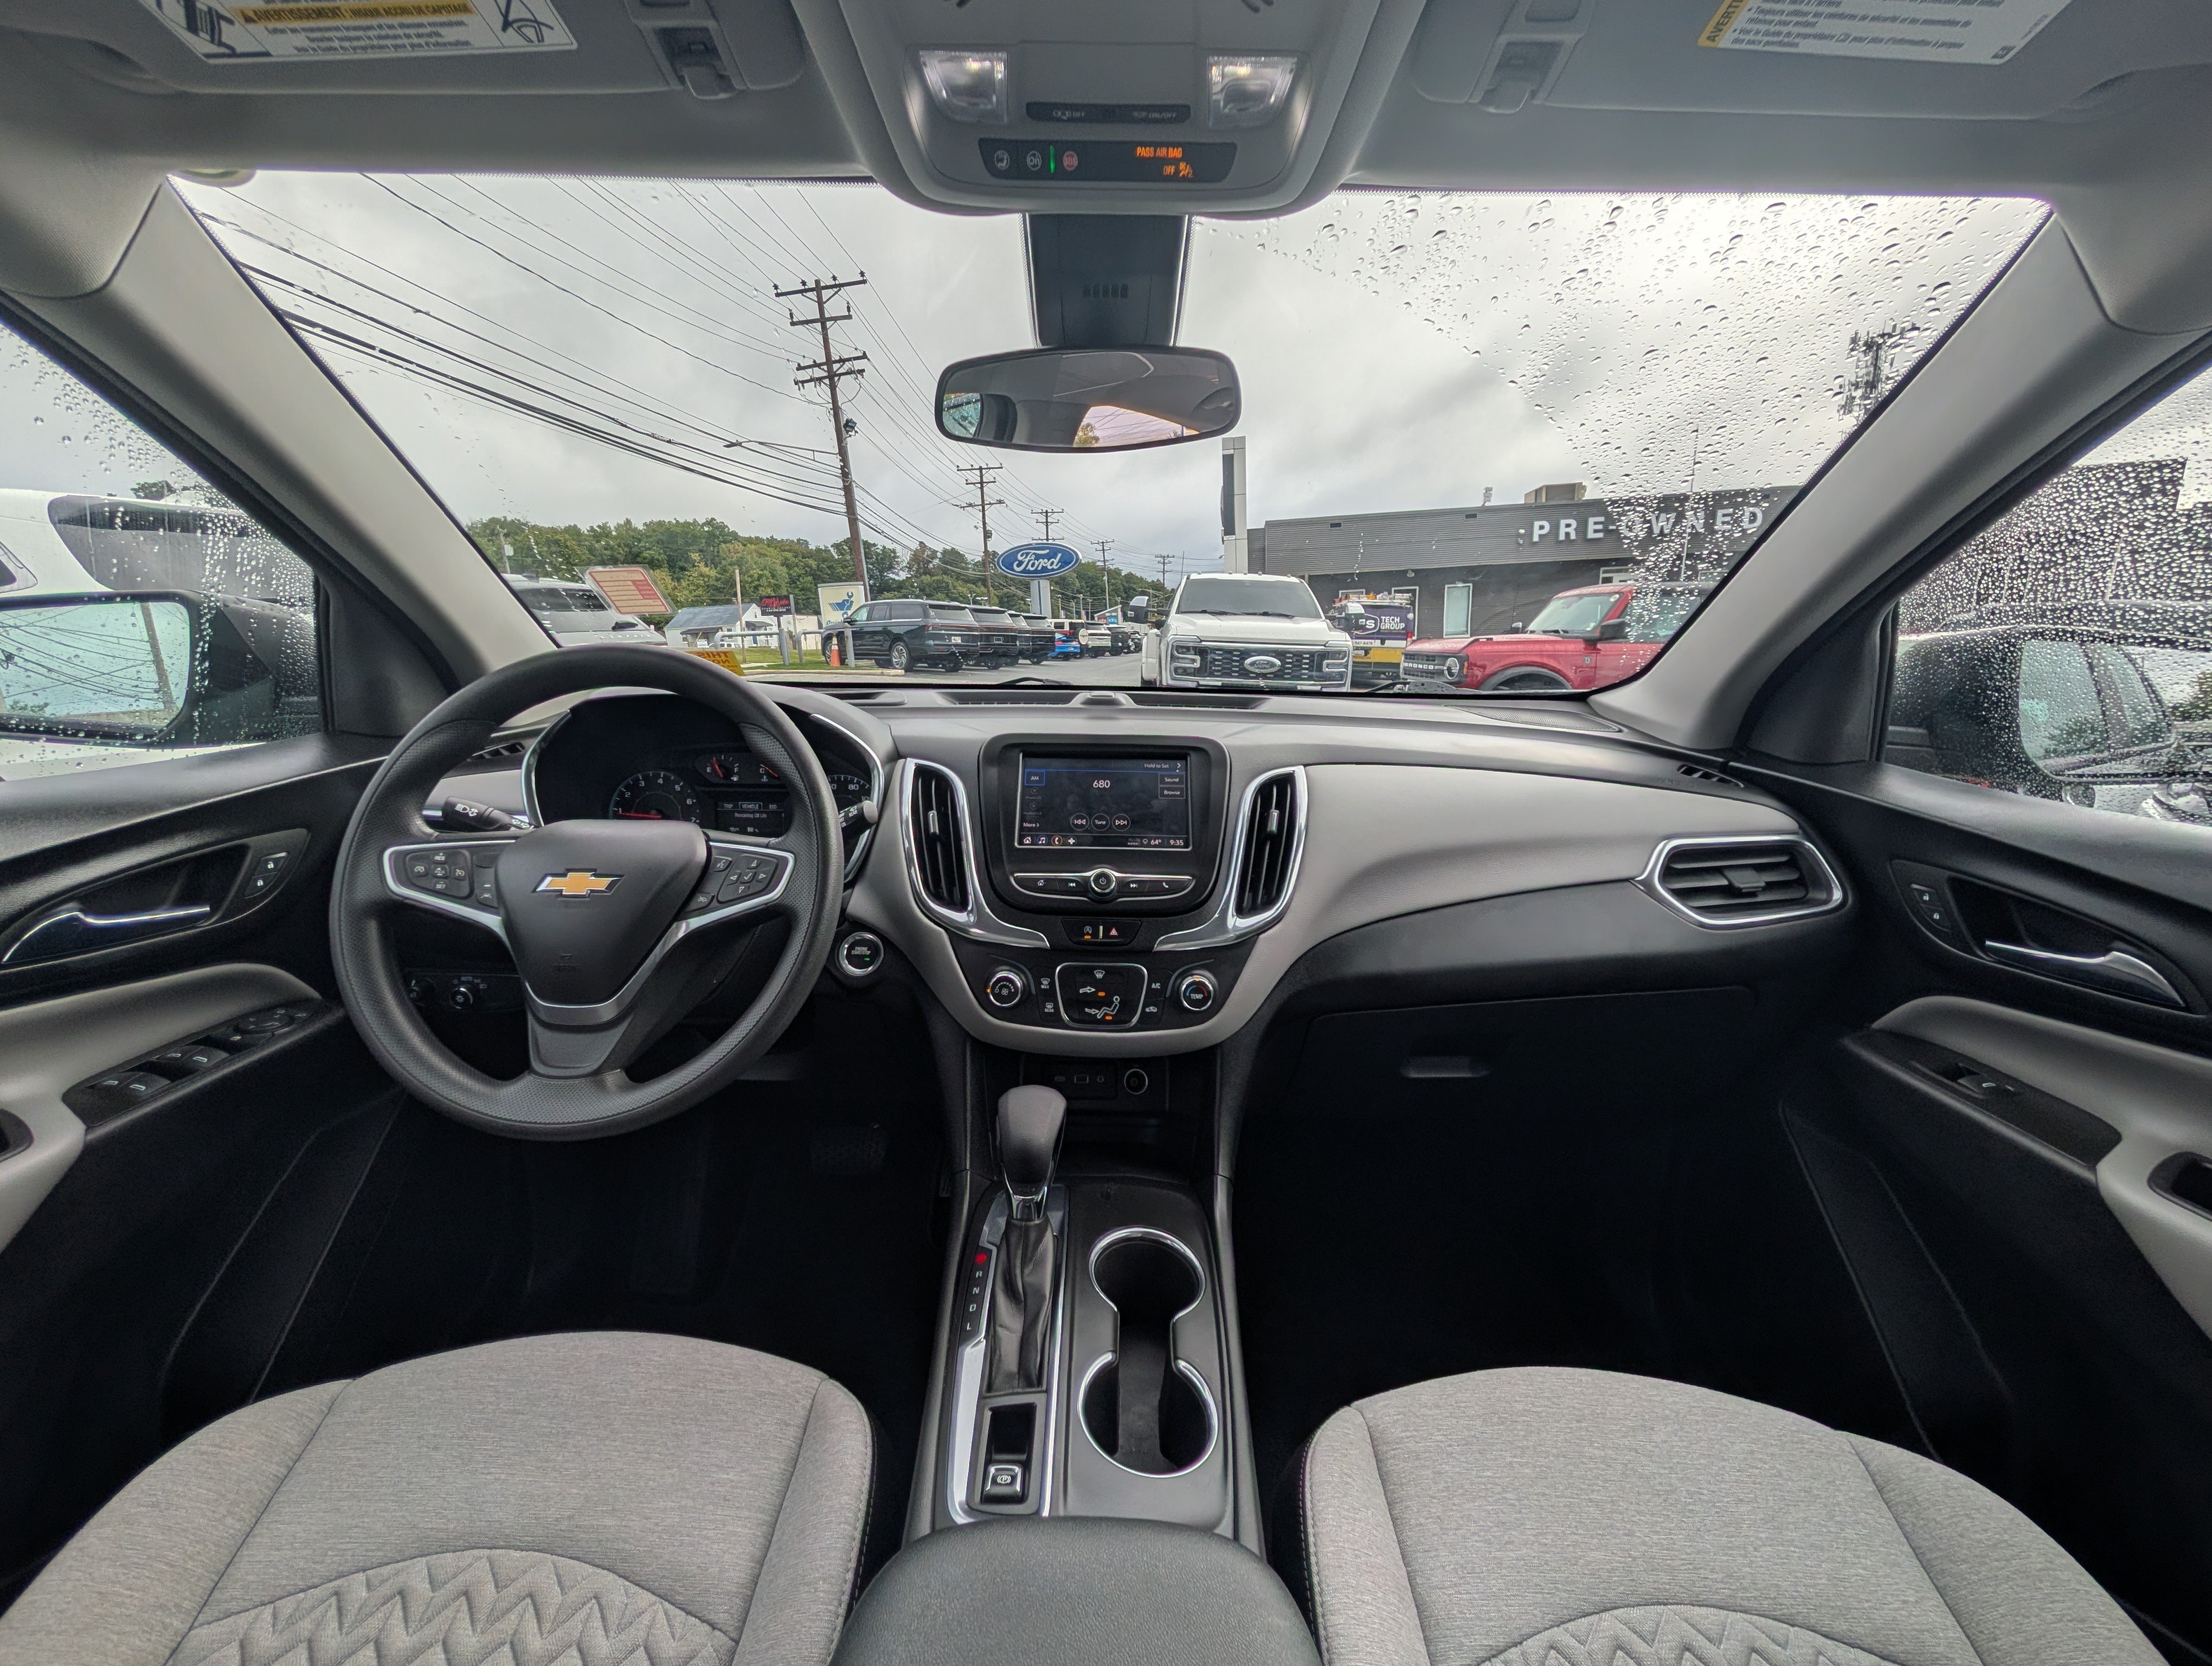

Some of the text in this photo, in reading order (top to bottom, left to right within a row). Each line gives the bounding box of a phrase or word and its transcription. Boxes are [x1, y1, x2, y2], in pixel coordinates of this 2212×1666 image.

[1137, 146, 1182, 158] PASS AIR BAG
[1163, 165, 1175, 175] OFF
[1013, 549, 1062, 572] Ford
[1254, 661, 1272, 669] Ford
[1093, 780, 1110, 788] 680
[973, 1286, 980, 1295] N
[969, 1304, 976, 1312] D
[967, 1322, 972, 1330] L
